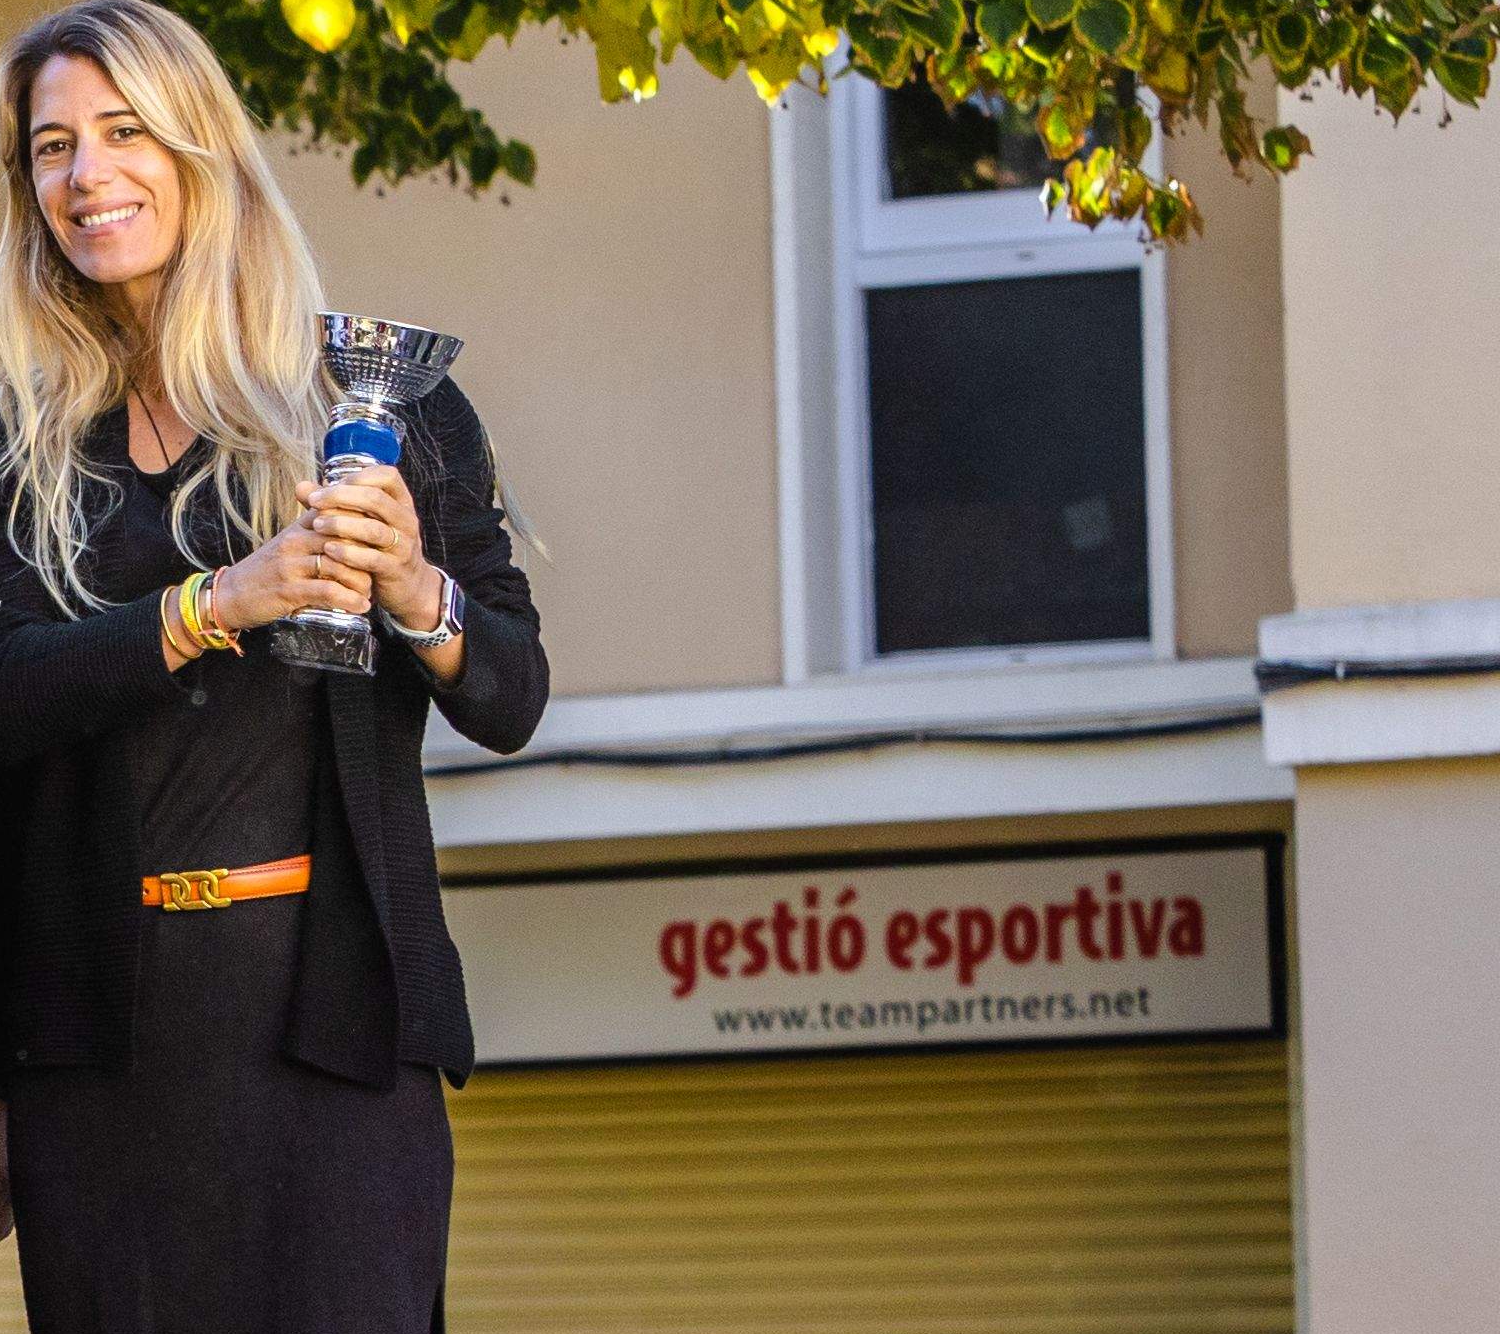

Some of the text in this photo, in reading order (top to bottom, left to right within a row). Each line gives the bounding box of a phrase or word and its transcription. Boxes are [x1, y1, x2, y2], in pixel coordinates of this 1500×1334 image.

[658, 870, 1207, 999] gestió esportiva
[712, 986, 1153, 1034] www.teampartners.net
